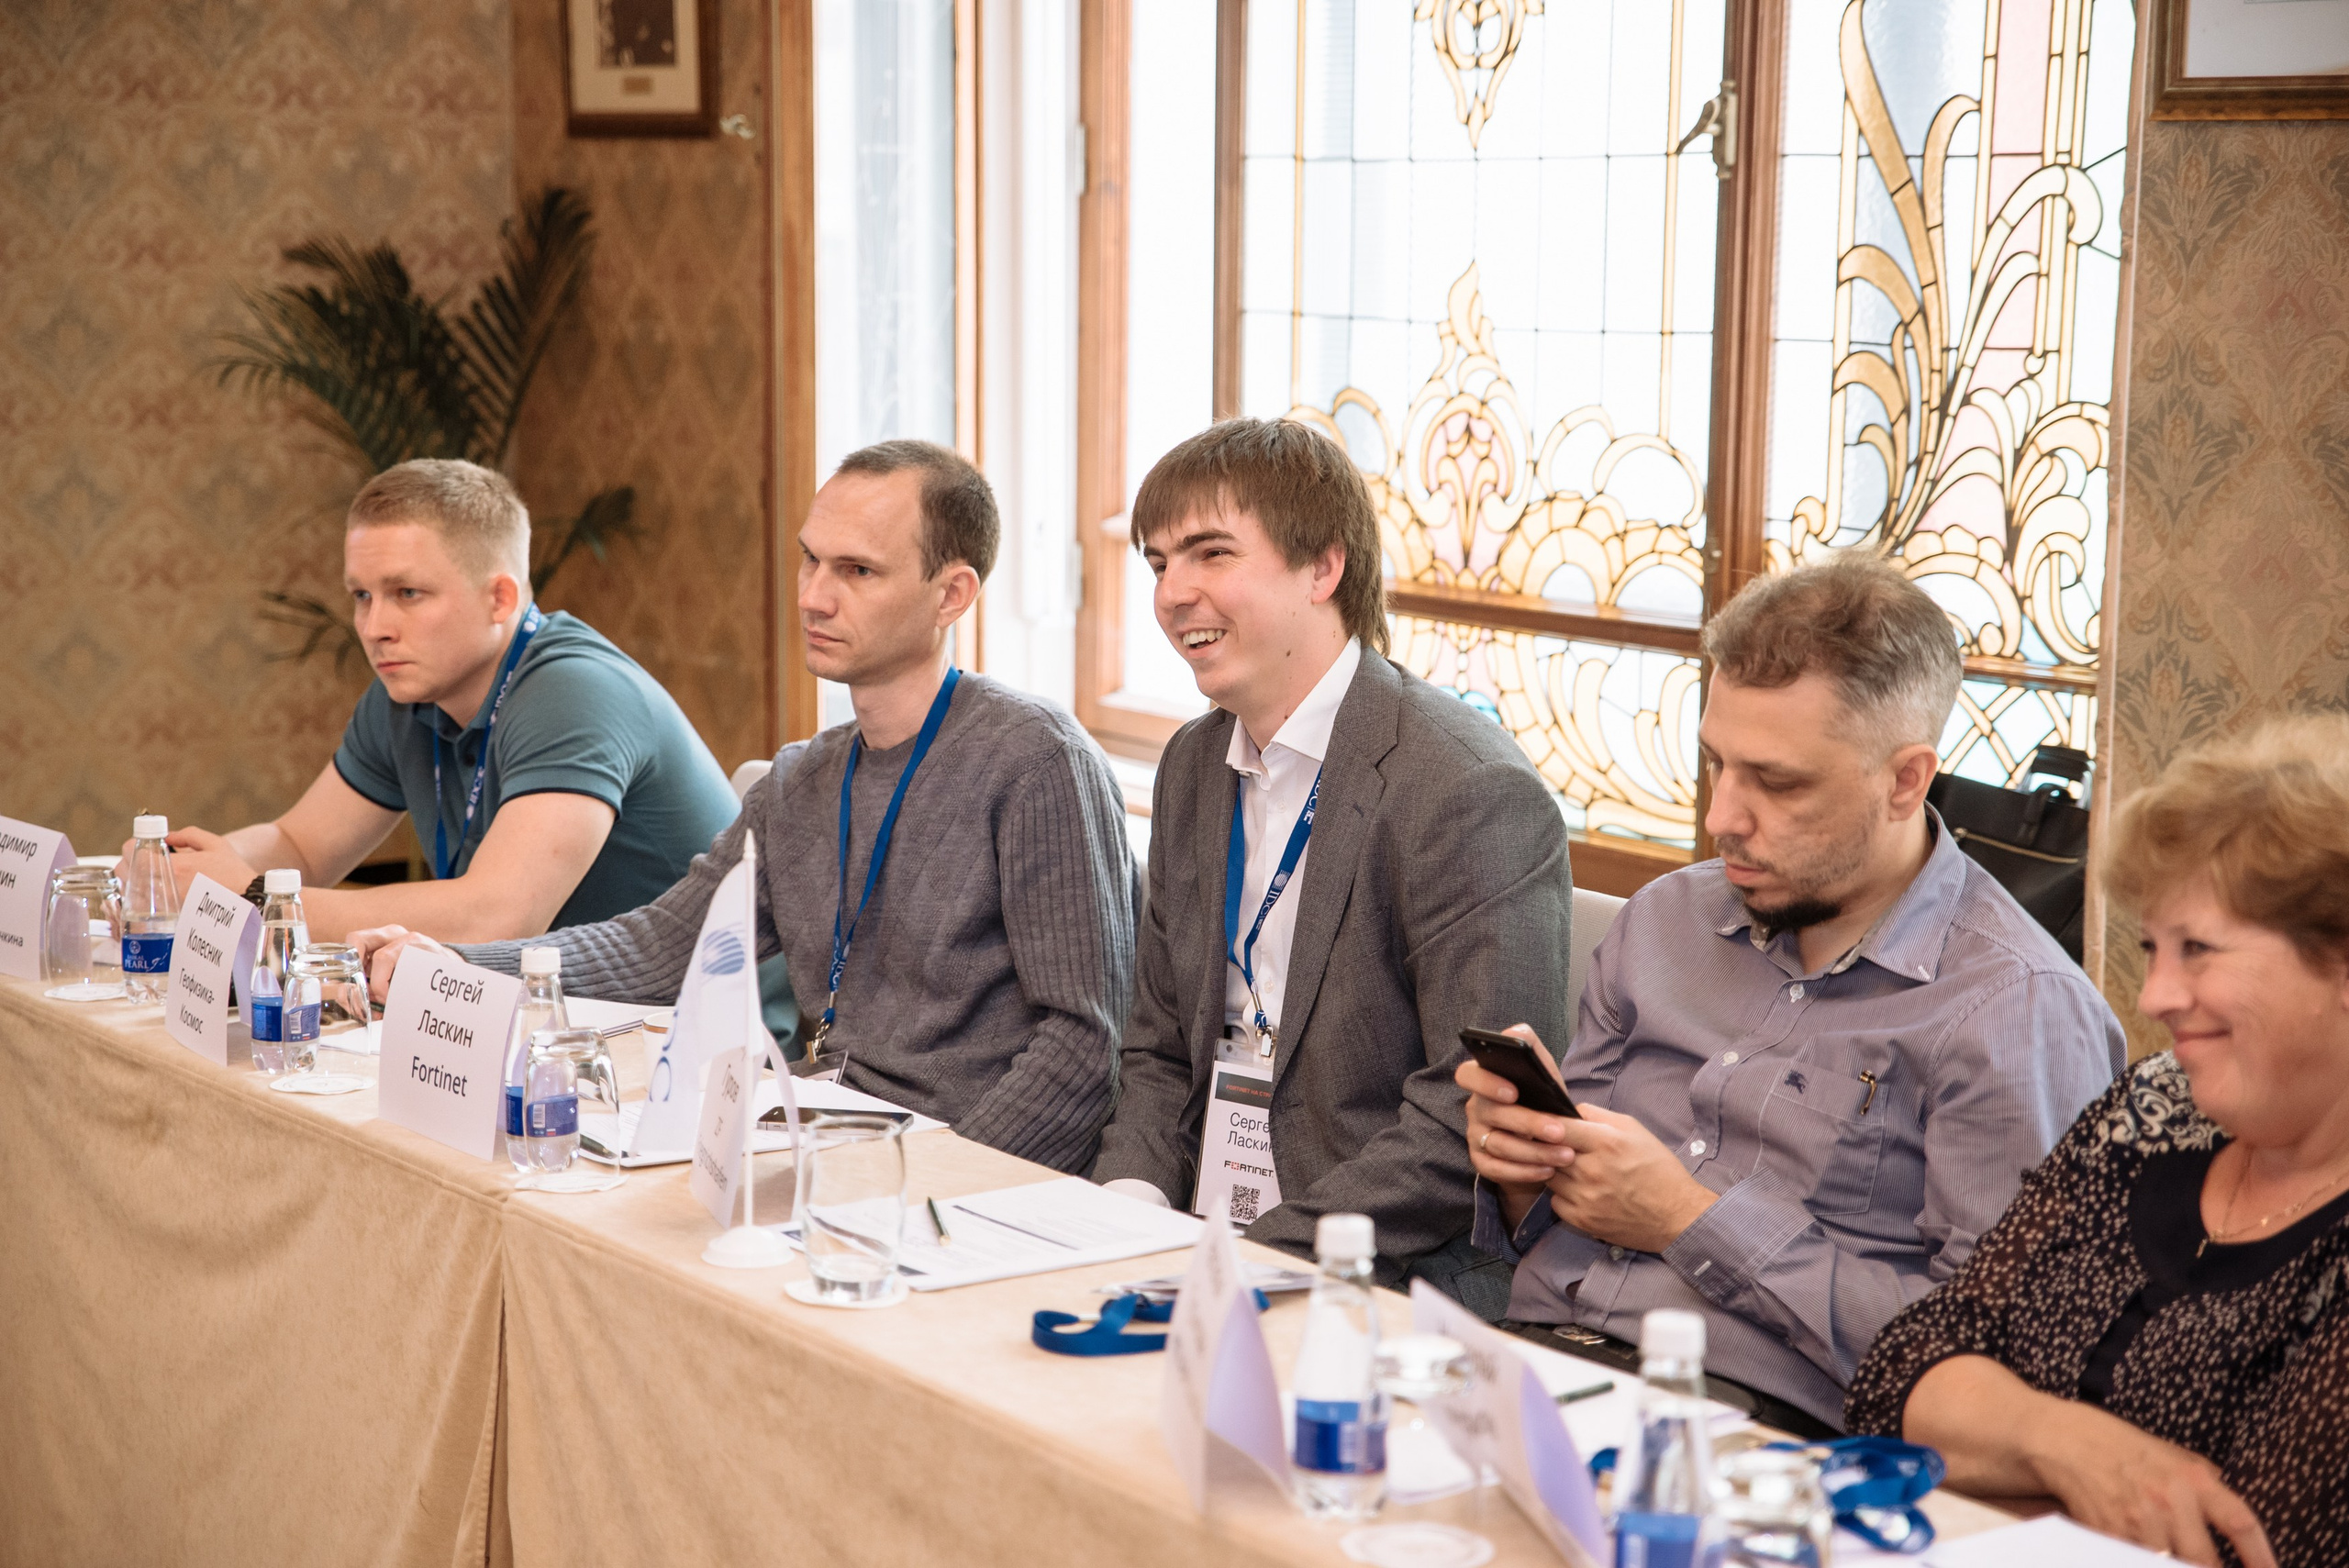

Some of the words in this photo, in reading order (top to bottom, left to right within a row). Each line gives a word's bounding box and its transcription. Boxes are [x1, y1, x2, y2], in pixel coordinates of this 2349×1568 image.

[0, 833, 38, 862] димир
[196, 892, 237, 928] Дмитрий
[1261, 889, 1281, 916] IDC
[124, 959, 150, 969] PEARL
[186, 927, 223, 967] Колесник
[178, 967, 216, 1005] Геофизика-
[430, 968, 484, 1006] Сергей
[179, 1002, 204, 1035] Космос
[417, 1009, 473, 1048] Ласкин
[412, 1056, 467, 1097] Fortinet
[1230, 1112, 1270, 1133] Серге
[1223, 1160, 1275, 1178] FORTINET
